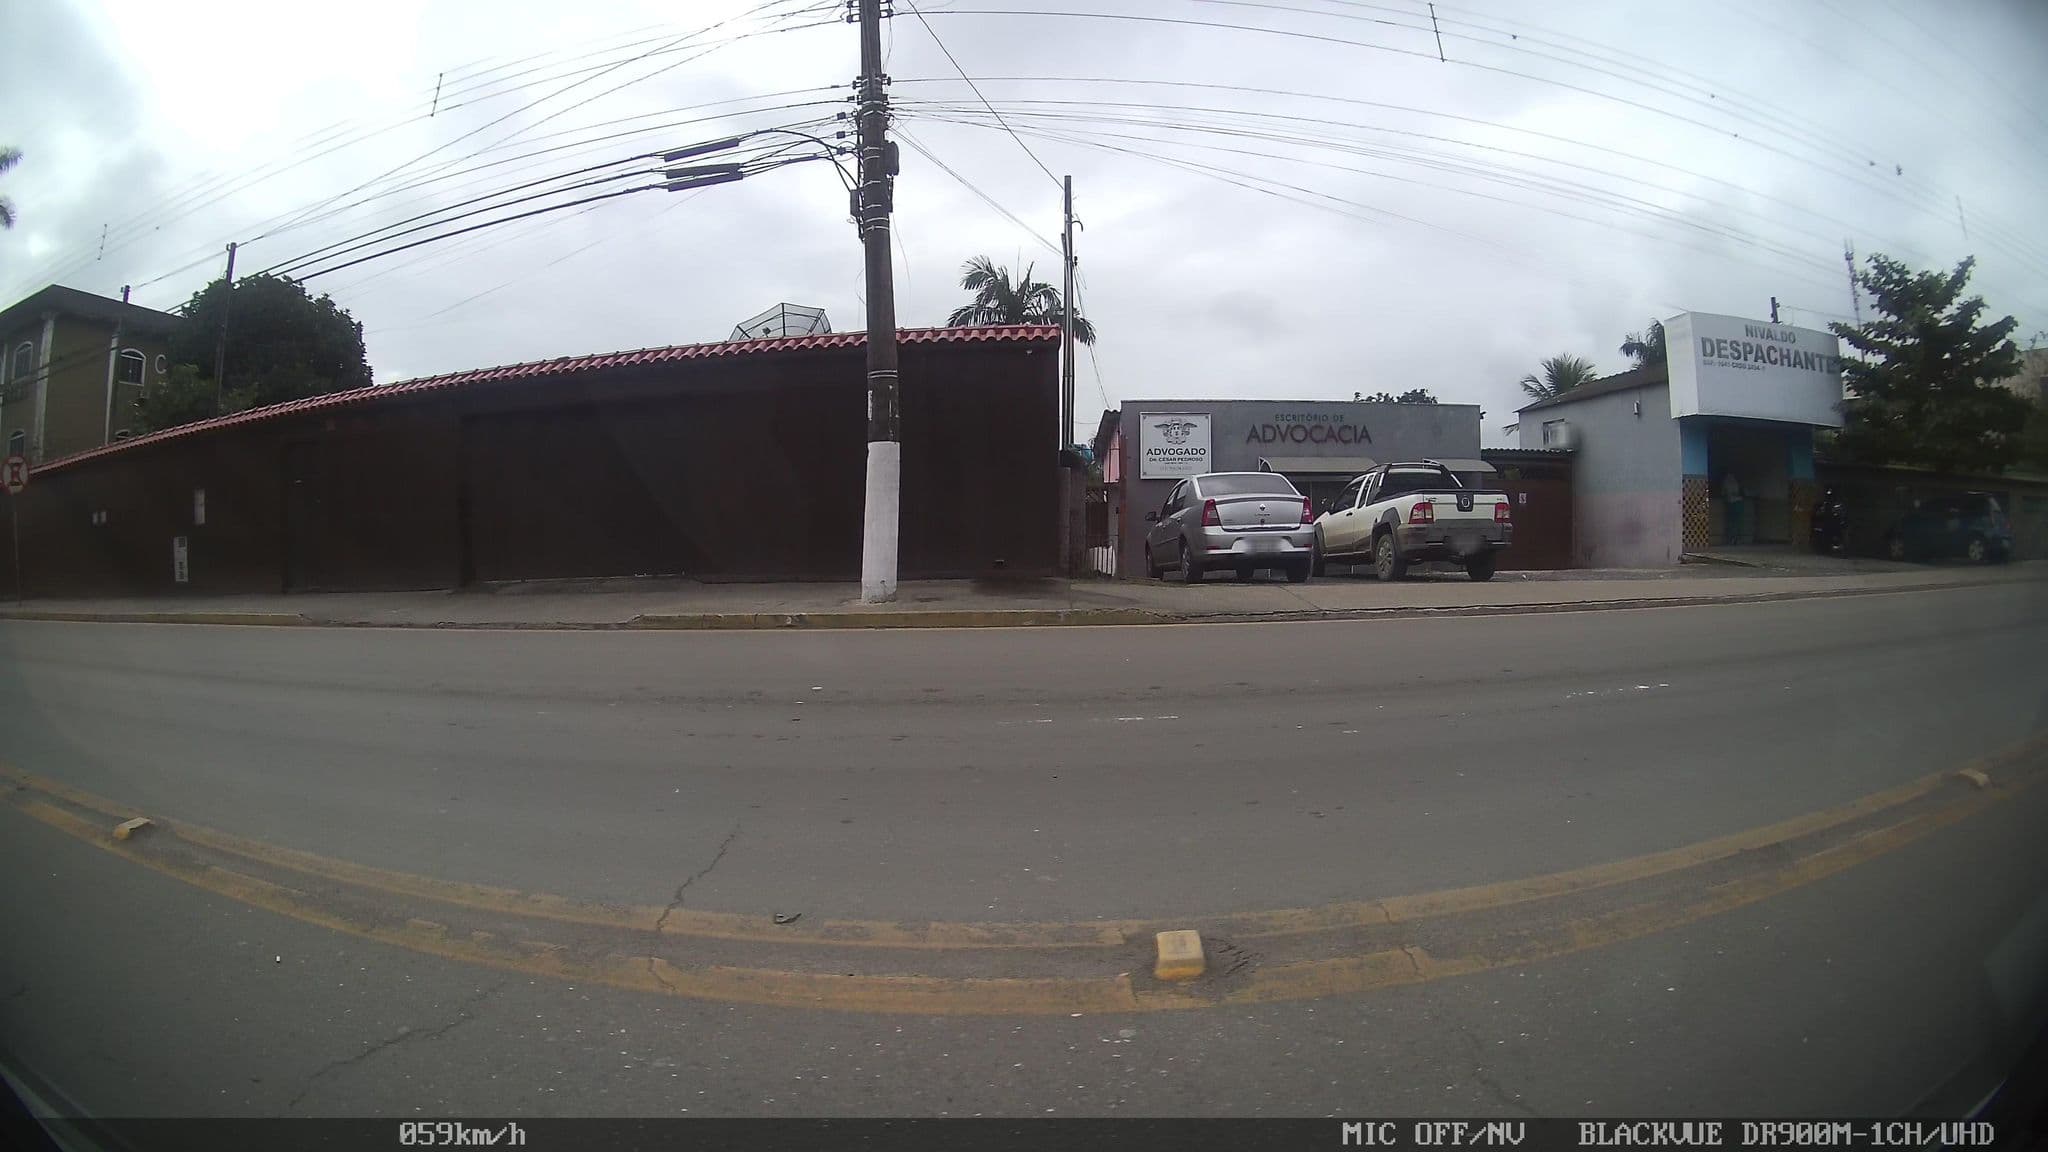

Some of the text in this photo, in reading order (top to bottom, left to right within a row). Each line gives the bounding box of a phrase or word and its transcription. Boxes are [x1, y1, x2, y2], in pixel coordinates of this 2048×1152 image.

[1745, 324, 1796, 344] NIVALDO
[1701, 336, 1840, 374] DESPACHANTE
[1246, 423, 1372, 444] ADVOCACIA
[1146, 447, 1206, 456] ADVOGADO
